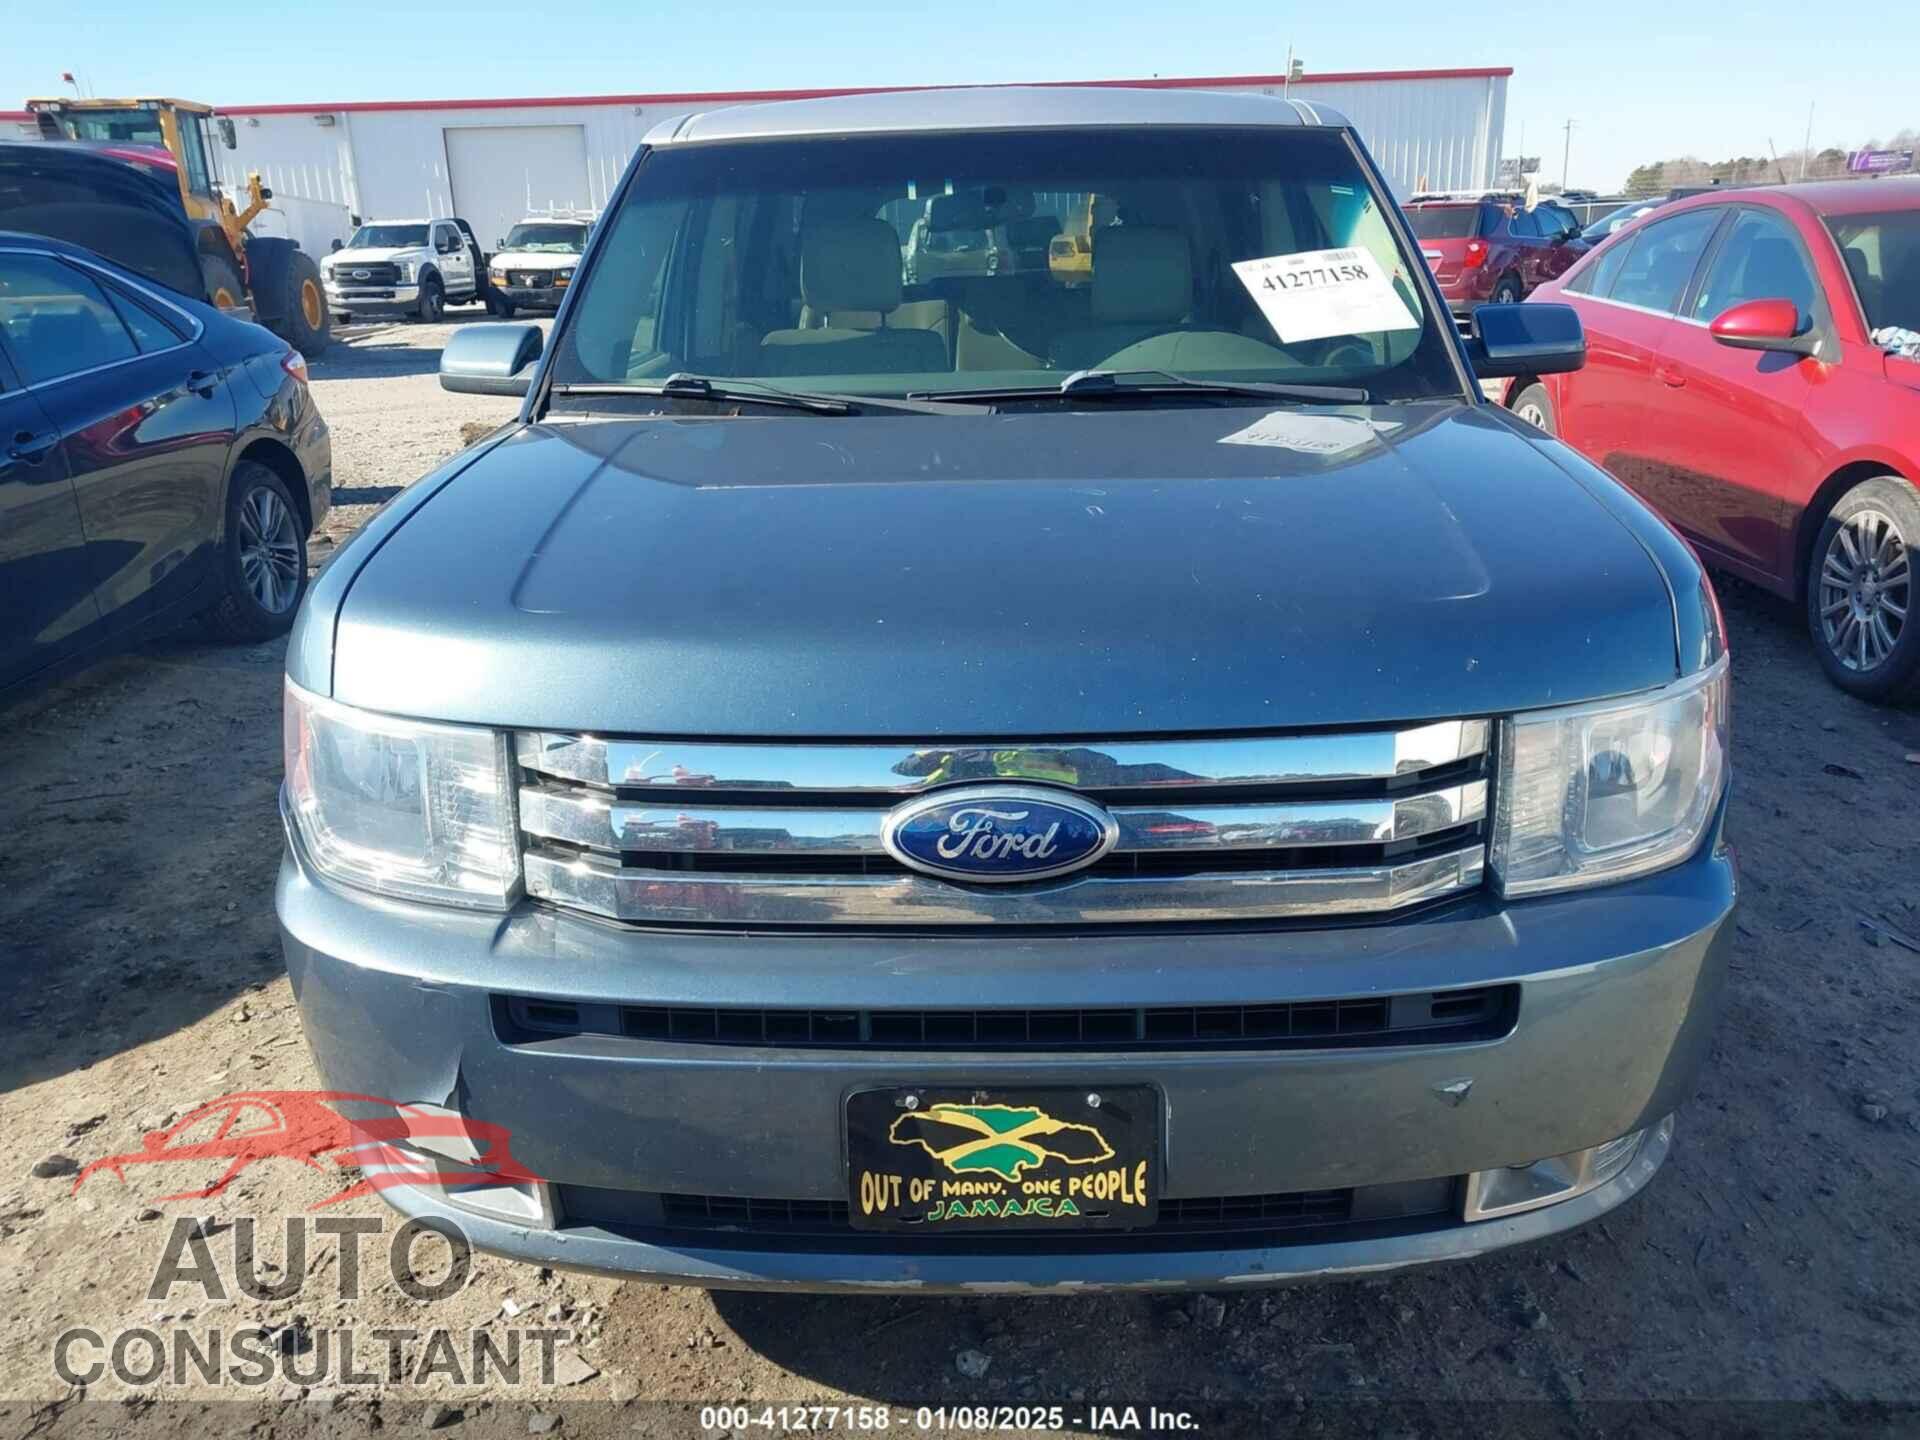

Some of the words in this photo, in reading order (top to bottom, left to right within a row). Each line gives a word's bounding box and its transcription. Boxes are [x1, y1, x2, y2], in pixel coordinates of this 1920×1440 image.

[1263, 265, 1368, 291] 41277158
[938, 808, 1058, 858] Ford
[861, 1171, 902, 1214] OUT
[911, 1178, 936, 1203] OF
[1022, 1178, 1061, 1195] ONE
[1069, 1161, 1147, 1206] PEOPLE
[929, 1198, 1080, 1221] JAMAICA
